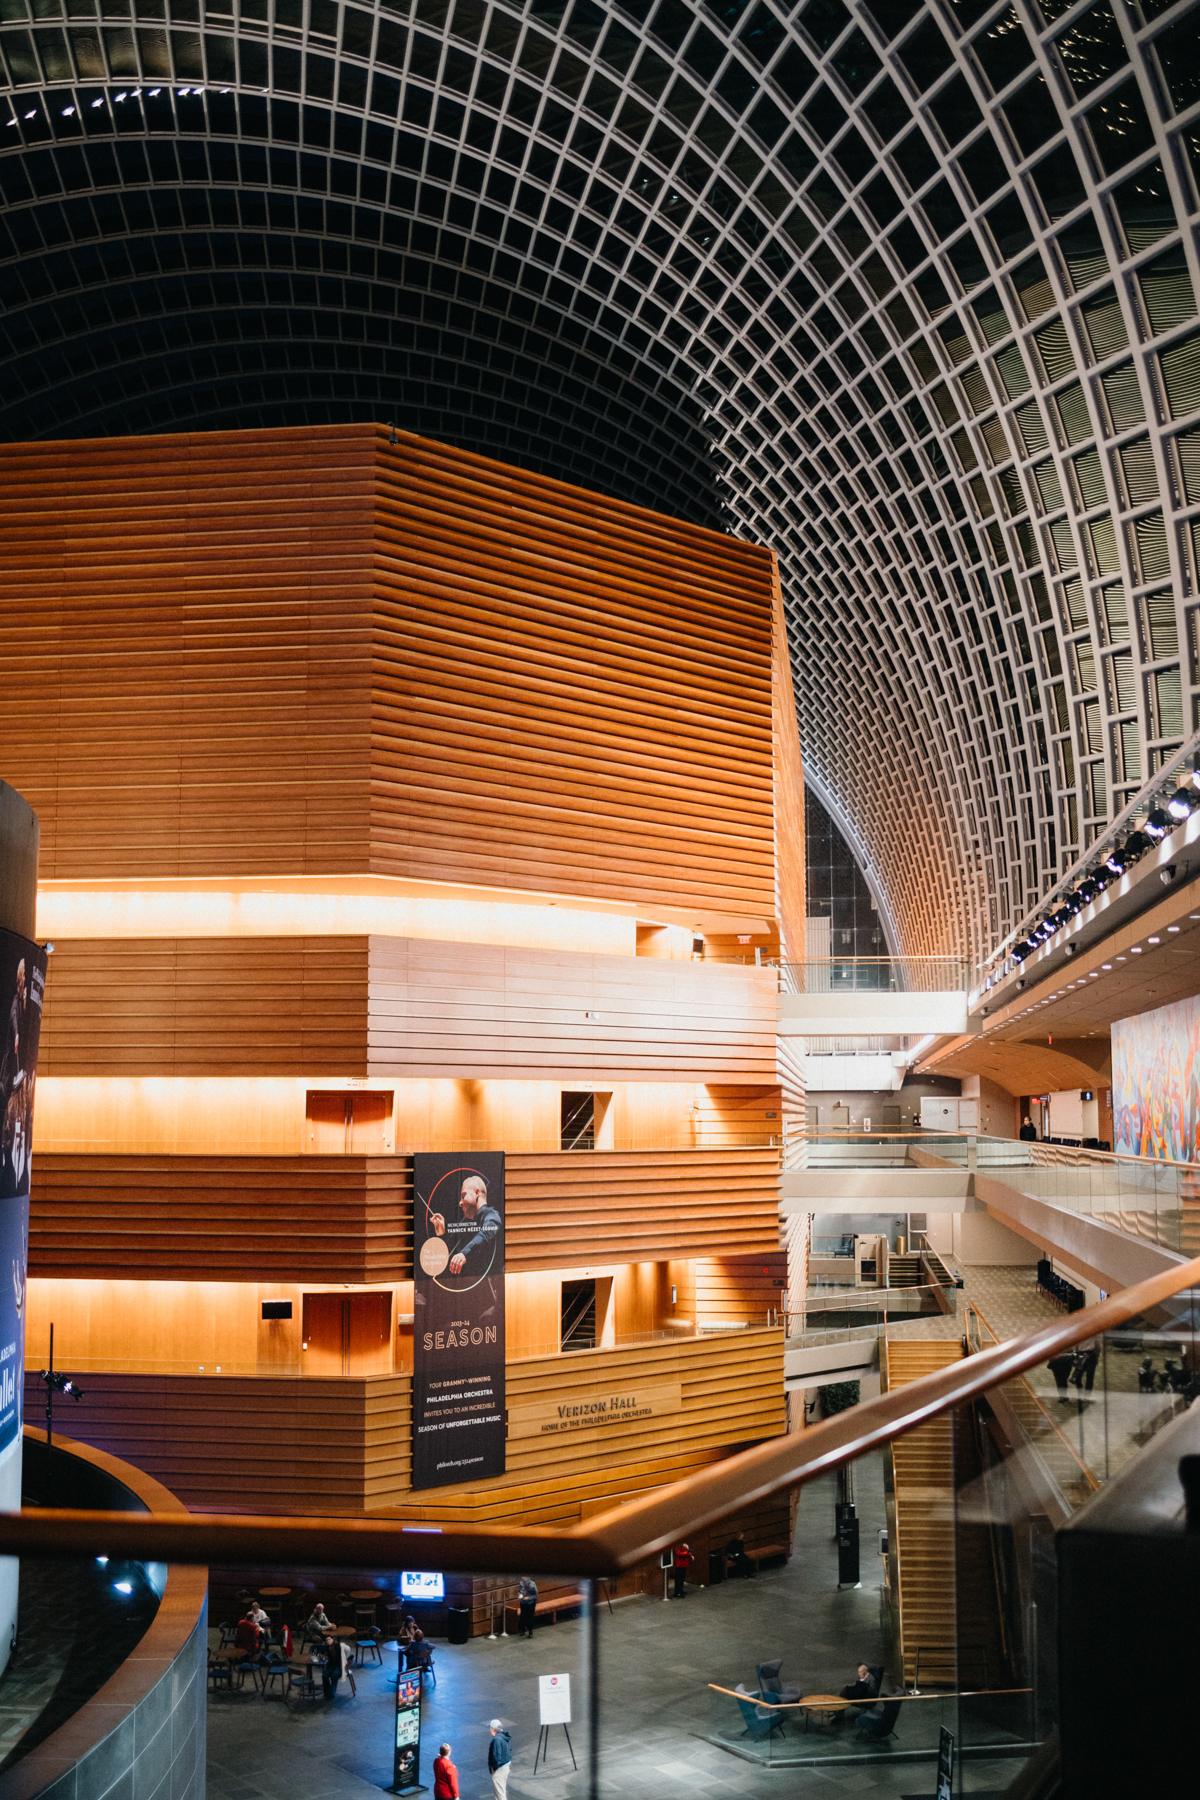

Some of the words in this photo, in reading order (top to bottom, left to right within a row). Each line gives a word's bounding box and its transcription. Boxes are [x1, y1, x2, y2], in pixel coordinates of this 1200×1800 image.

[424, 1326, 496, 1350] SEASON
[0, 1342, 16, 1363] ADELPHIA
[426, 1393, 463, 1403] PHILADELPHIA
[464, 1389, 493, 1398] ORCHESTRA
[424, 1410, 442, 1418] INVITES
[469, 1402, 496, 1411] INCREDIBLE
[558, 1402, 606, 1418] VERIZON
[610, 1397, 637, 1410] HALL
[418, 1424, 438, 1433] SEASON
[446, 1416, 485, 1428] UNFORGETTABLE
[542, 1423, 559, 1431] HOME
[582, 1414, 620, 1425] PHILADELPHIA
[622, 1408, 652, 1418] ORCHESTRA
